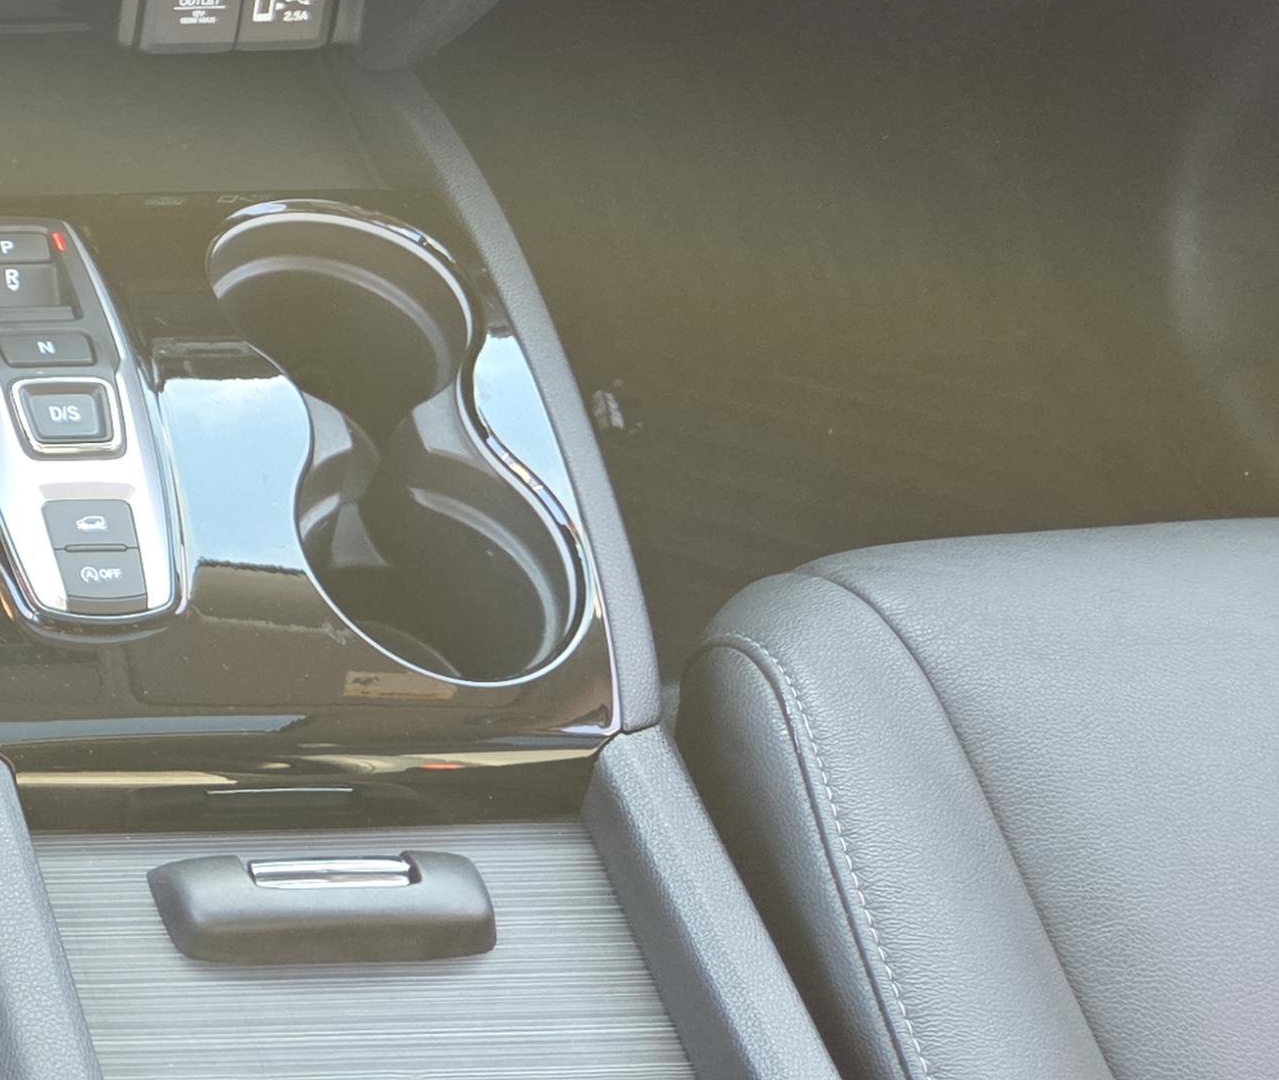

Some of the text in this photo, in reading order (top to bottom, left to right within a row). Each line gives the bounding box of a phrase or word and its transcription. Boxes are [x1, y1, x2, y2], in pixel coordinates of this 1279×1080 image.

[0, 241, 14, 254] P
[5, 268, 19, 284] R
[37, 341, 55, 354] N
[49, 405, 80, 421] D/S
[99, 568, 122, 579] OFF
